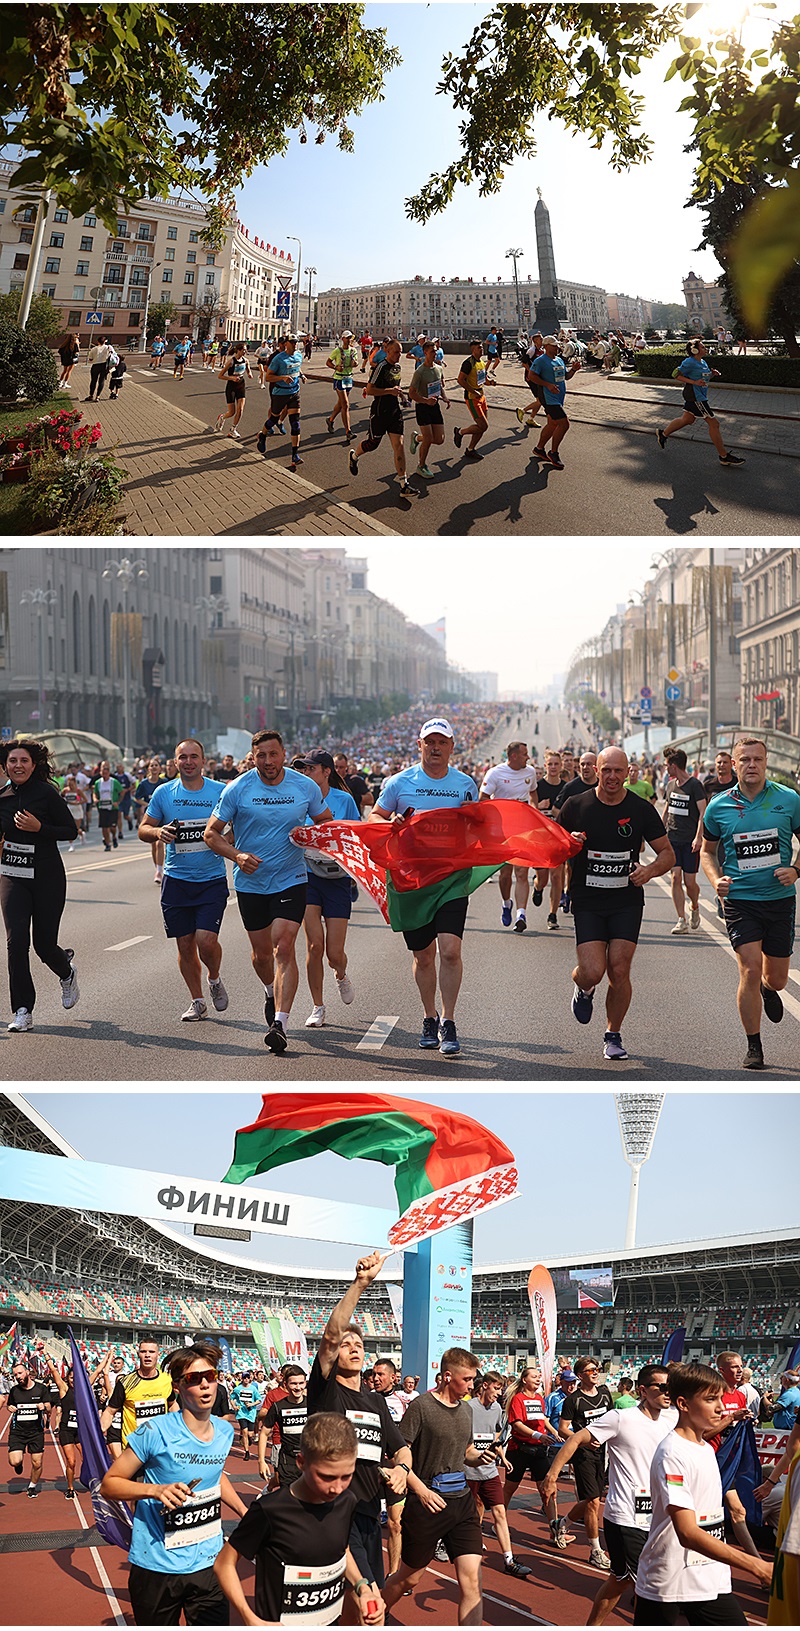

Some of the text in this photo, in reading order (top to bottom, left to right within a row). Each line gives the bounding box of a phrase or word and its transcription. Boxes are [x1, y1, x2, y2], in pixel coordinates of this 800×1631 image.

[742, 842, 773, 856] 21329
[5, 854, 28, 865] 21724
[592, 864, 624, 874] 32347
[157, 1185, 290, 1226] ФИНИШ
[140, 1406, 161, 1416] 39881
[174, 1503, 215, 1526] 38784
[295, 1581, 341, 1607] 35915
